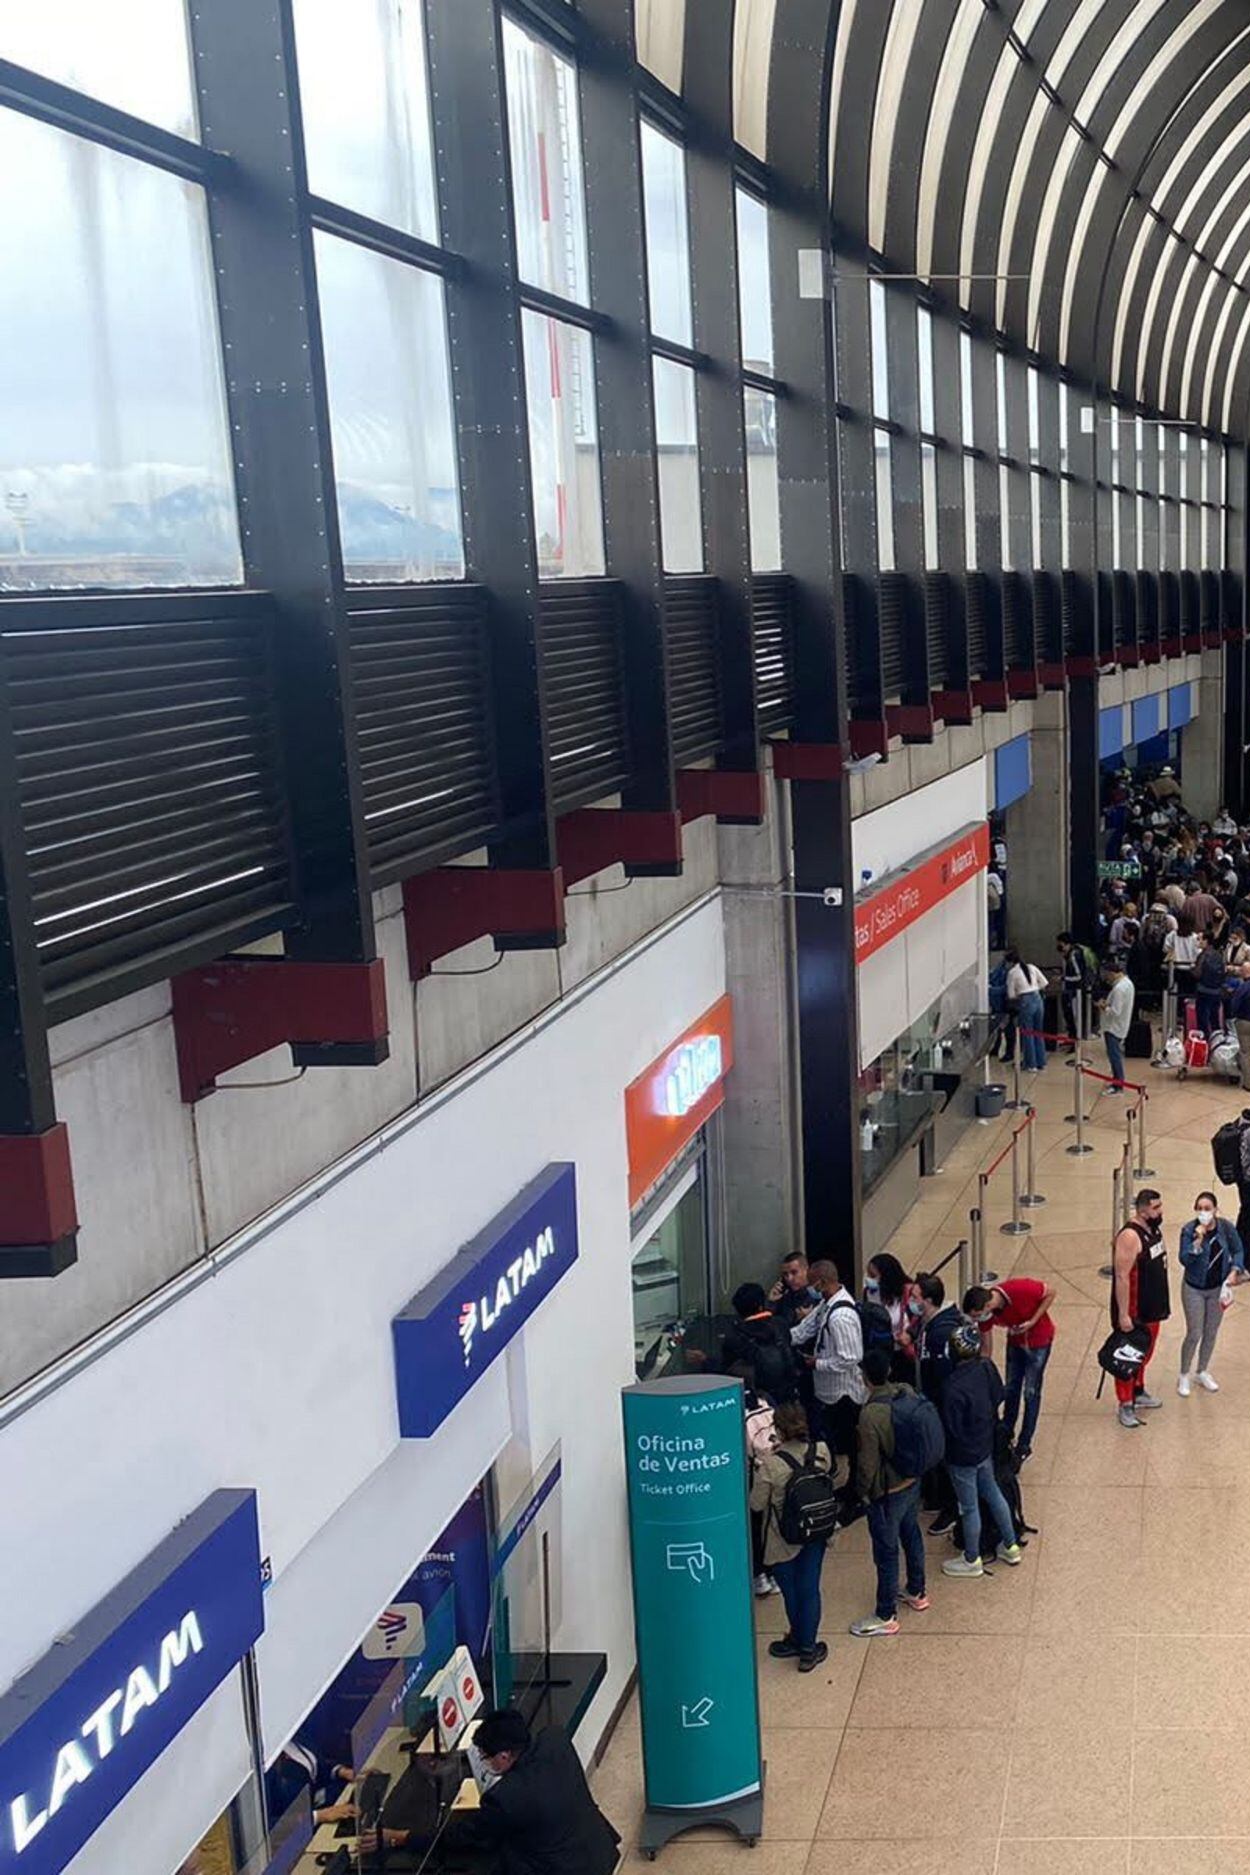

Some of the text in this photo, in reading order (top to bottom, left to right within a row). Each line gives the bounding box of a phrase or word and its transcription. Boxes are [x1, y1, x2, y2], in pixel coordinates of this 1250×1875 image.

[480, 1226, 554, 1332] LATAM
[692, 1398, 736, 1414] LATAM
[637, 1435, 705, 1452] Oficina
[638, 1452, 731, 1473] de Ventas
[640, 1482, 712, 1495] Ticket Office
[11, 1610, 203, 1854] LATAM
